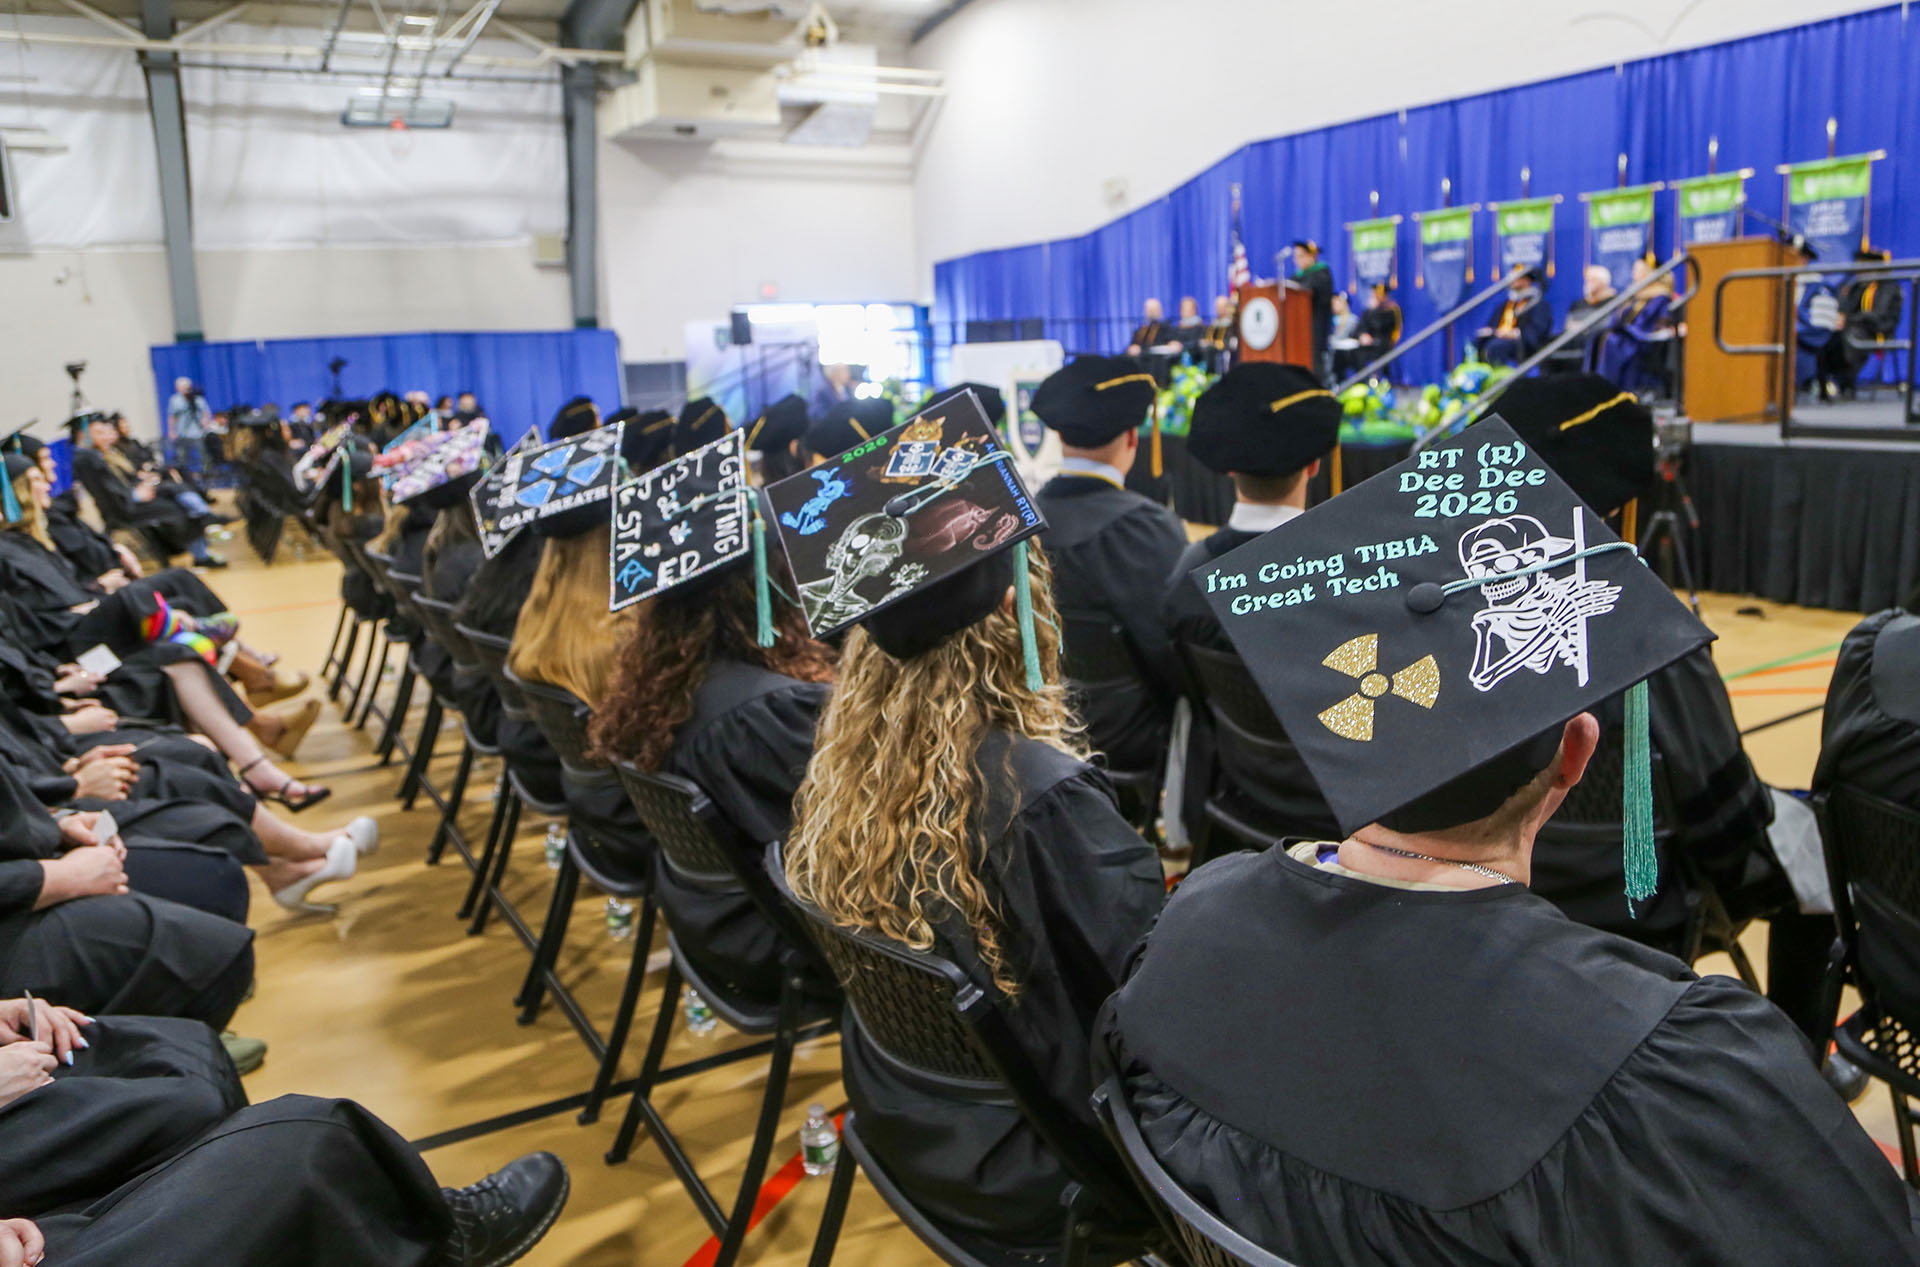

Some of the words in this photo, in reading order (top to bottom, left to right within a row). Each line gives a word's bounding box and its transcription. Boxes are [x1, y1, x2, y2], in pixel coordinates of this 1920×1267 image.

[842, 436, 888, 464] 2026
[1417, 448, 1464, 469] RT
[1477, 441, 1527, 468] (R)
[1398, 471, 1465, 493] Dee
[1479, 466, 1547, 489] Dee
[1016, 497, 1037, 526] RT(R)
[1414, 489, 1520, 518] 2026
[499, 508, 537, 530] CAN
[1206, 568, 1248, 594] I'm
[1258, 553, 1345, 584] Going
[1354, 534, 1439, 564] TIBIA
[1230, 587, 1316, 616] Great
[1326, 566, 1400, 598] Tech
